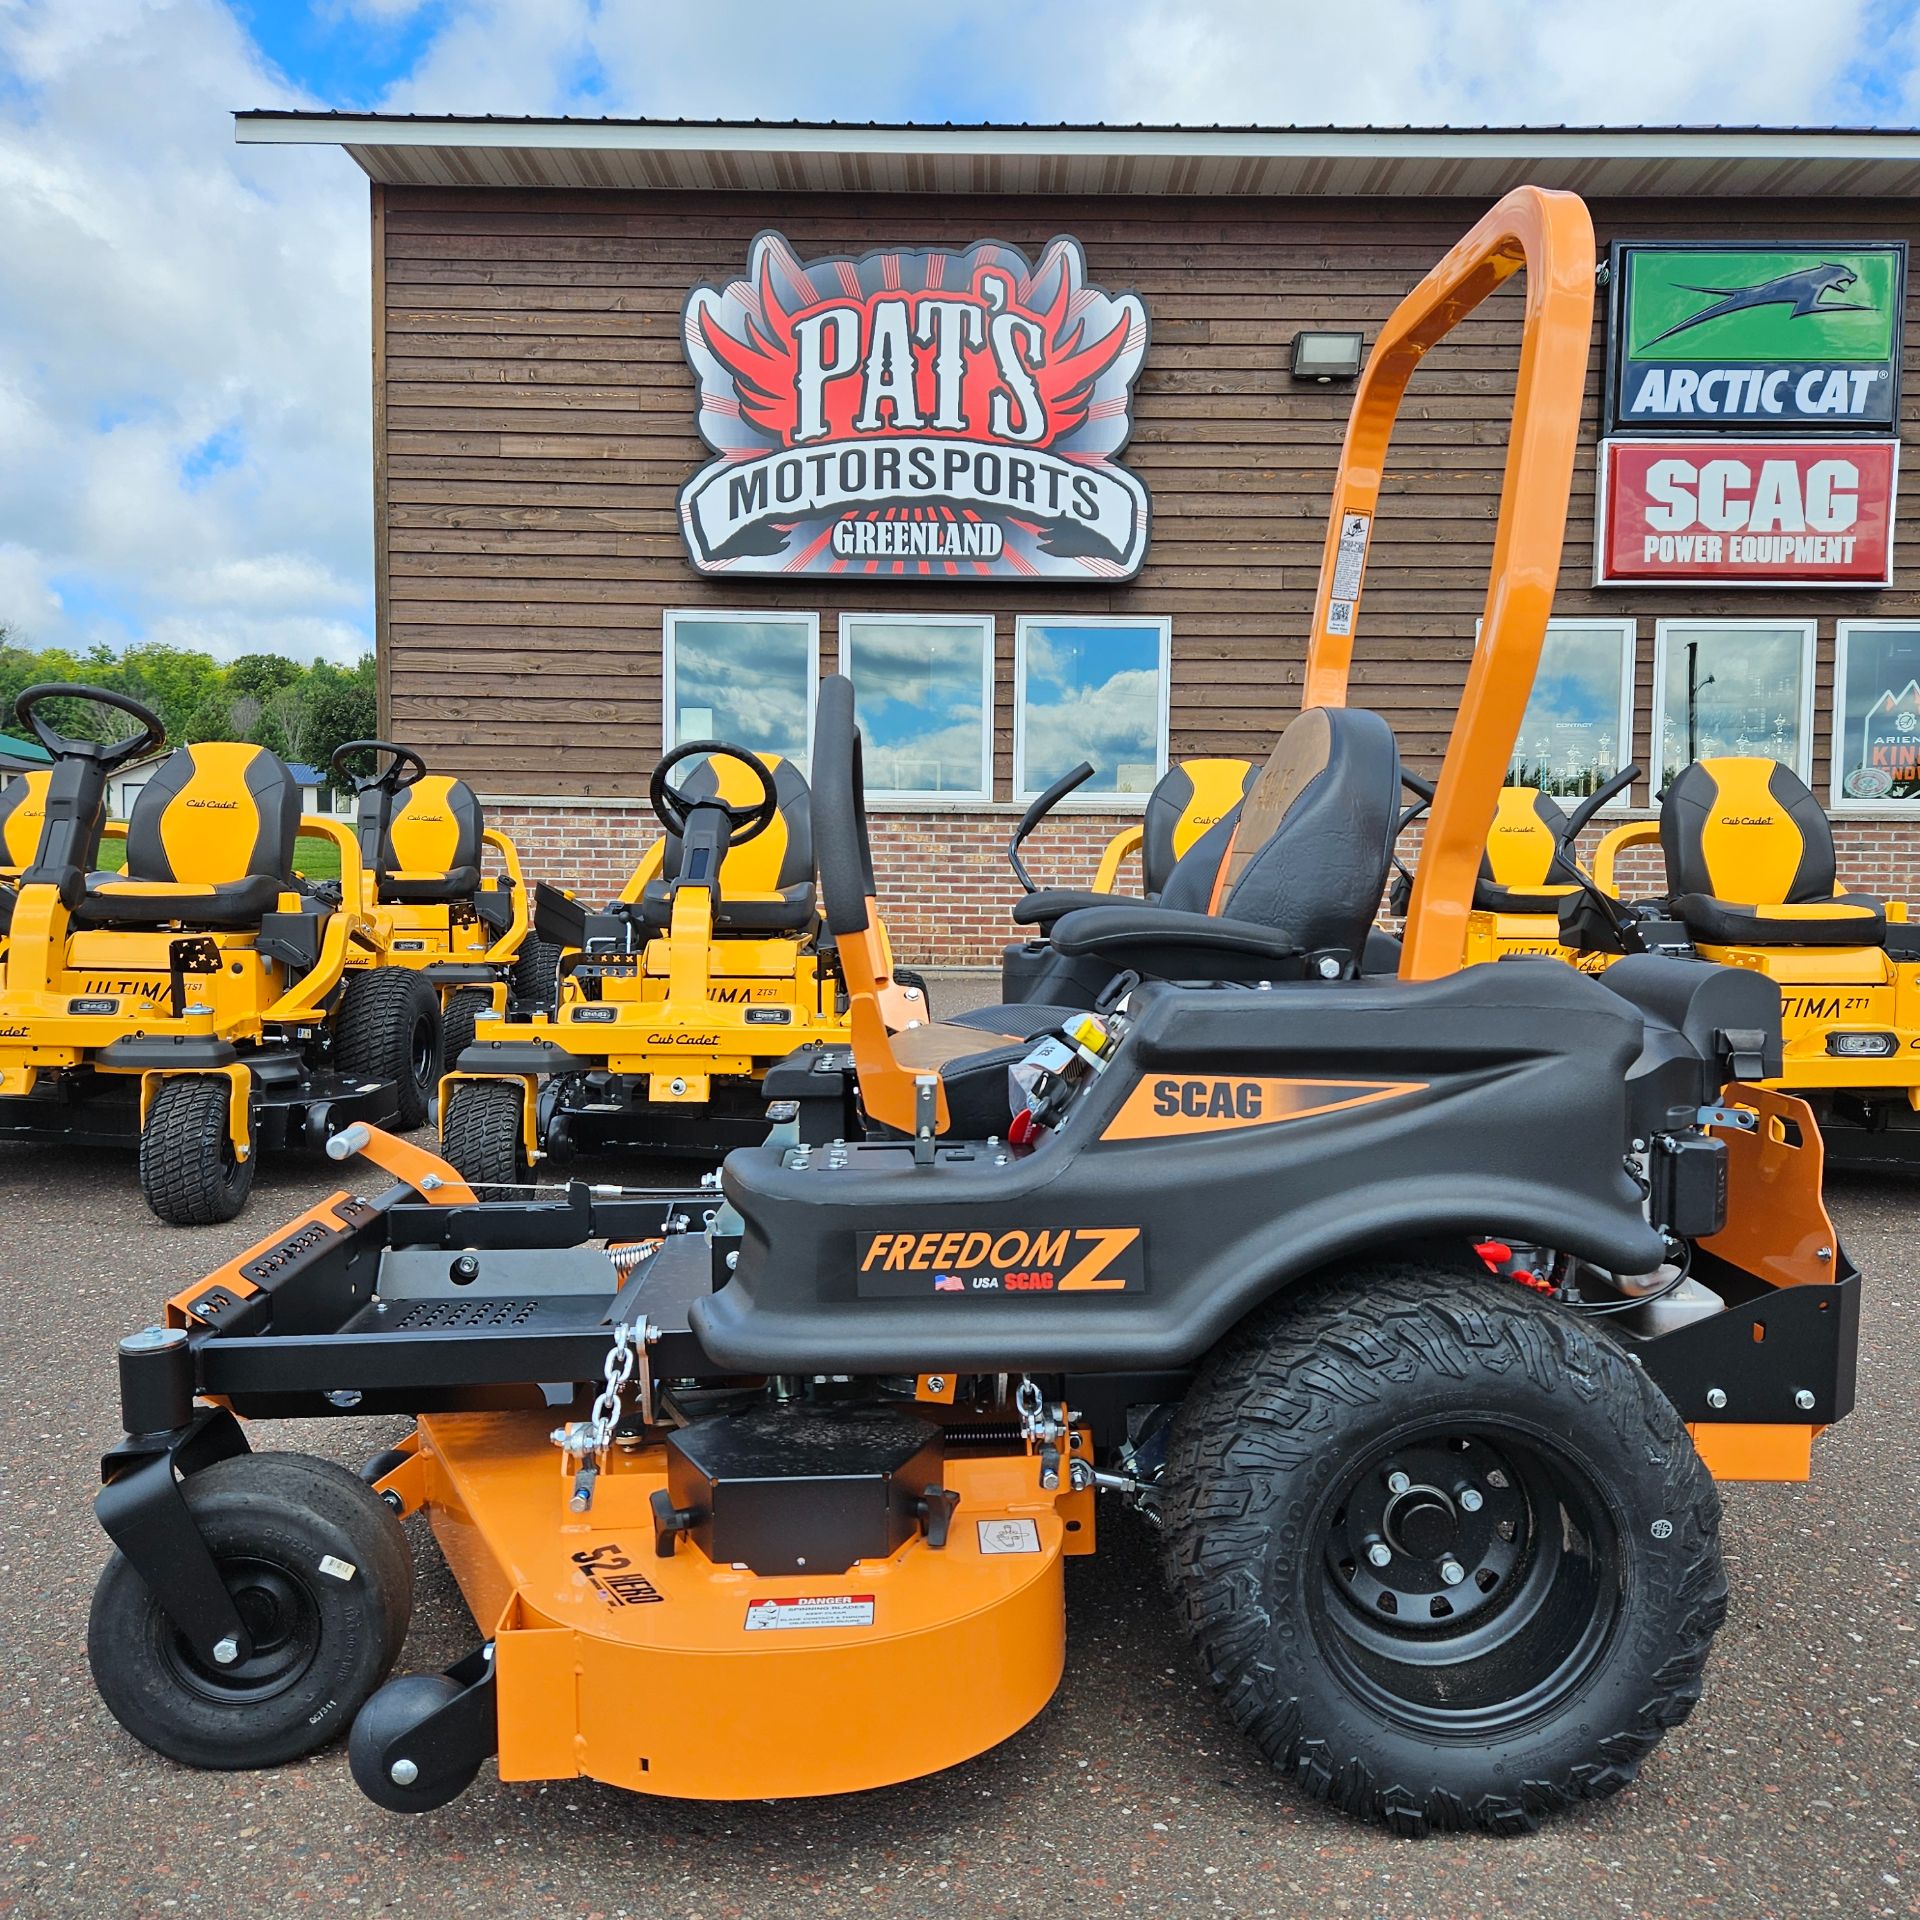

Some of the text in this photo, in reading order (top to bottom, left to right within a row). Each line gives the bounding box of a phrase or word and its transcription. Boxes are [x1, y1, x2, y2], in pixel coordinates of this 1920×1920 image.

[794, 276, 1046, 442] PAT'S
[1630, 369, 1792, 414] ARCTIC
[728, 447, 1101, 521] MOTORSPORTS
[1644, 459, 1860, 533] SCAG
[833, 521, 1001, 556] GREENLAND
[1643, 536, 1858, 565] POWER EQUIPMENT
[1874, 736, 1920, 744] ARIEN
[1872, 745, 1920, 766] KIN
[186, 799, 240, 809] Cub Cadet
[1193, 816, 1211, 824] Cub
[1721, 816, 1775, 825] Cub Cadet
[1781, 998, 1870, 1019] TIMA ZT1
[647, 1034, 721, 1046] Cub Cadet
[1154, 1080, 1262, 1119] SCAG
[860, 1227, 1141, 1291] FREEDOM Z
[972, 1272, 1054, 1291] USA SCAG
[571, 1544, 665, 1604] 52 HERO
[797, 1596, 853, 1605] DANGER
